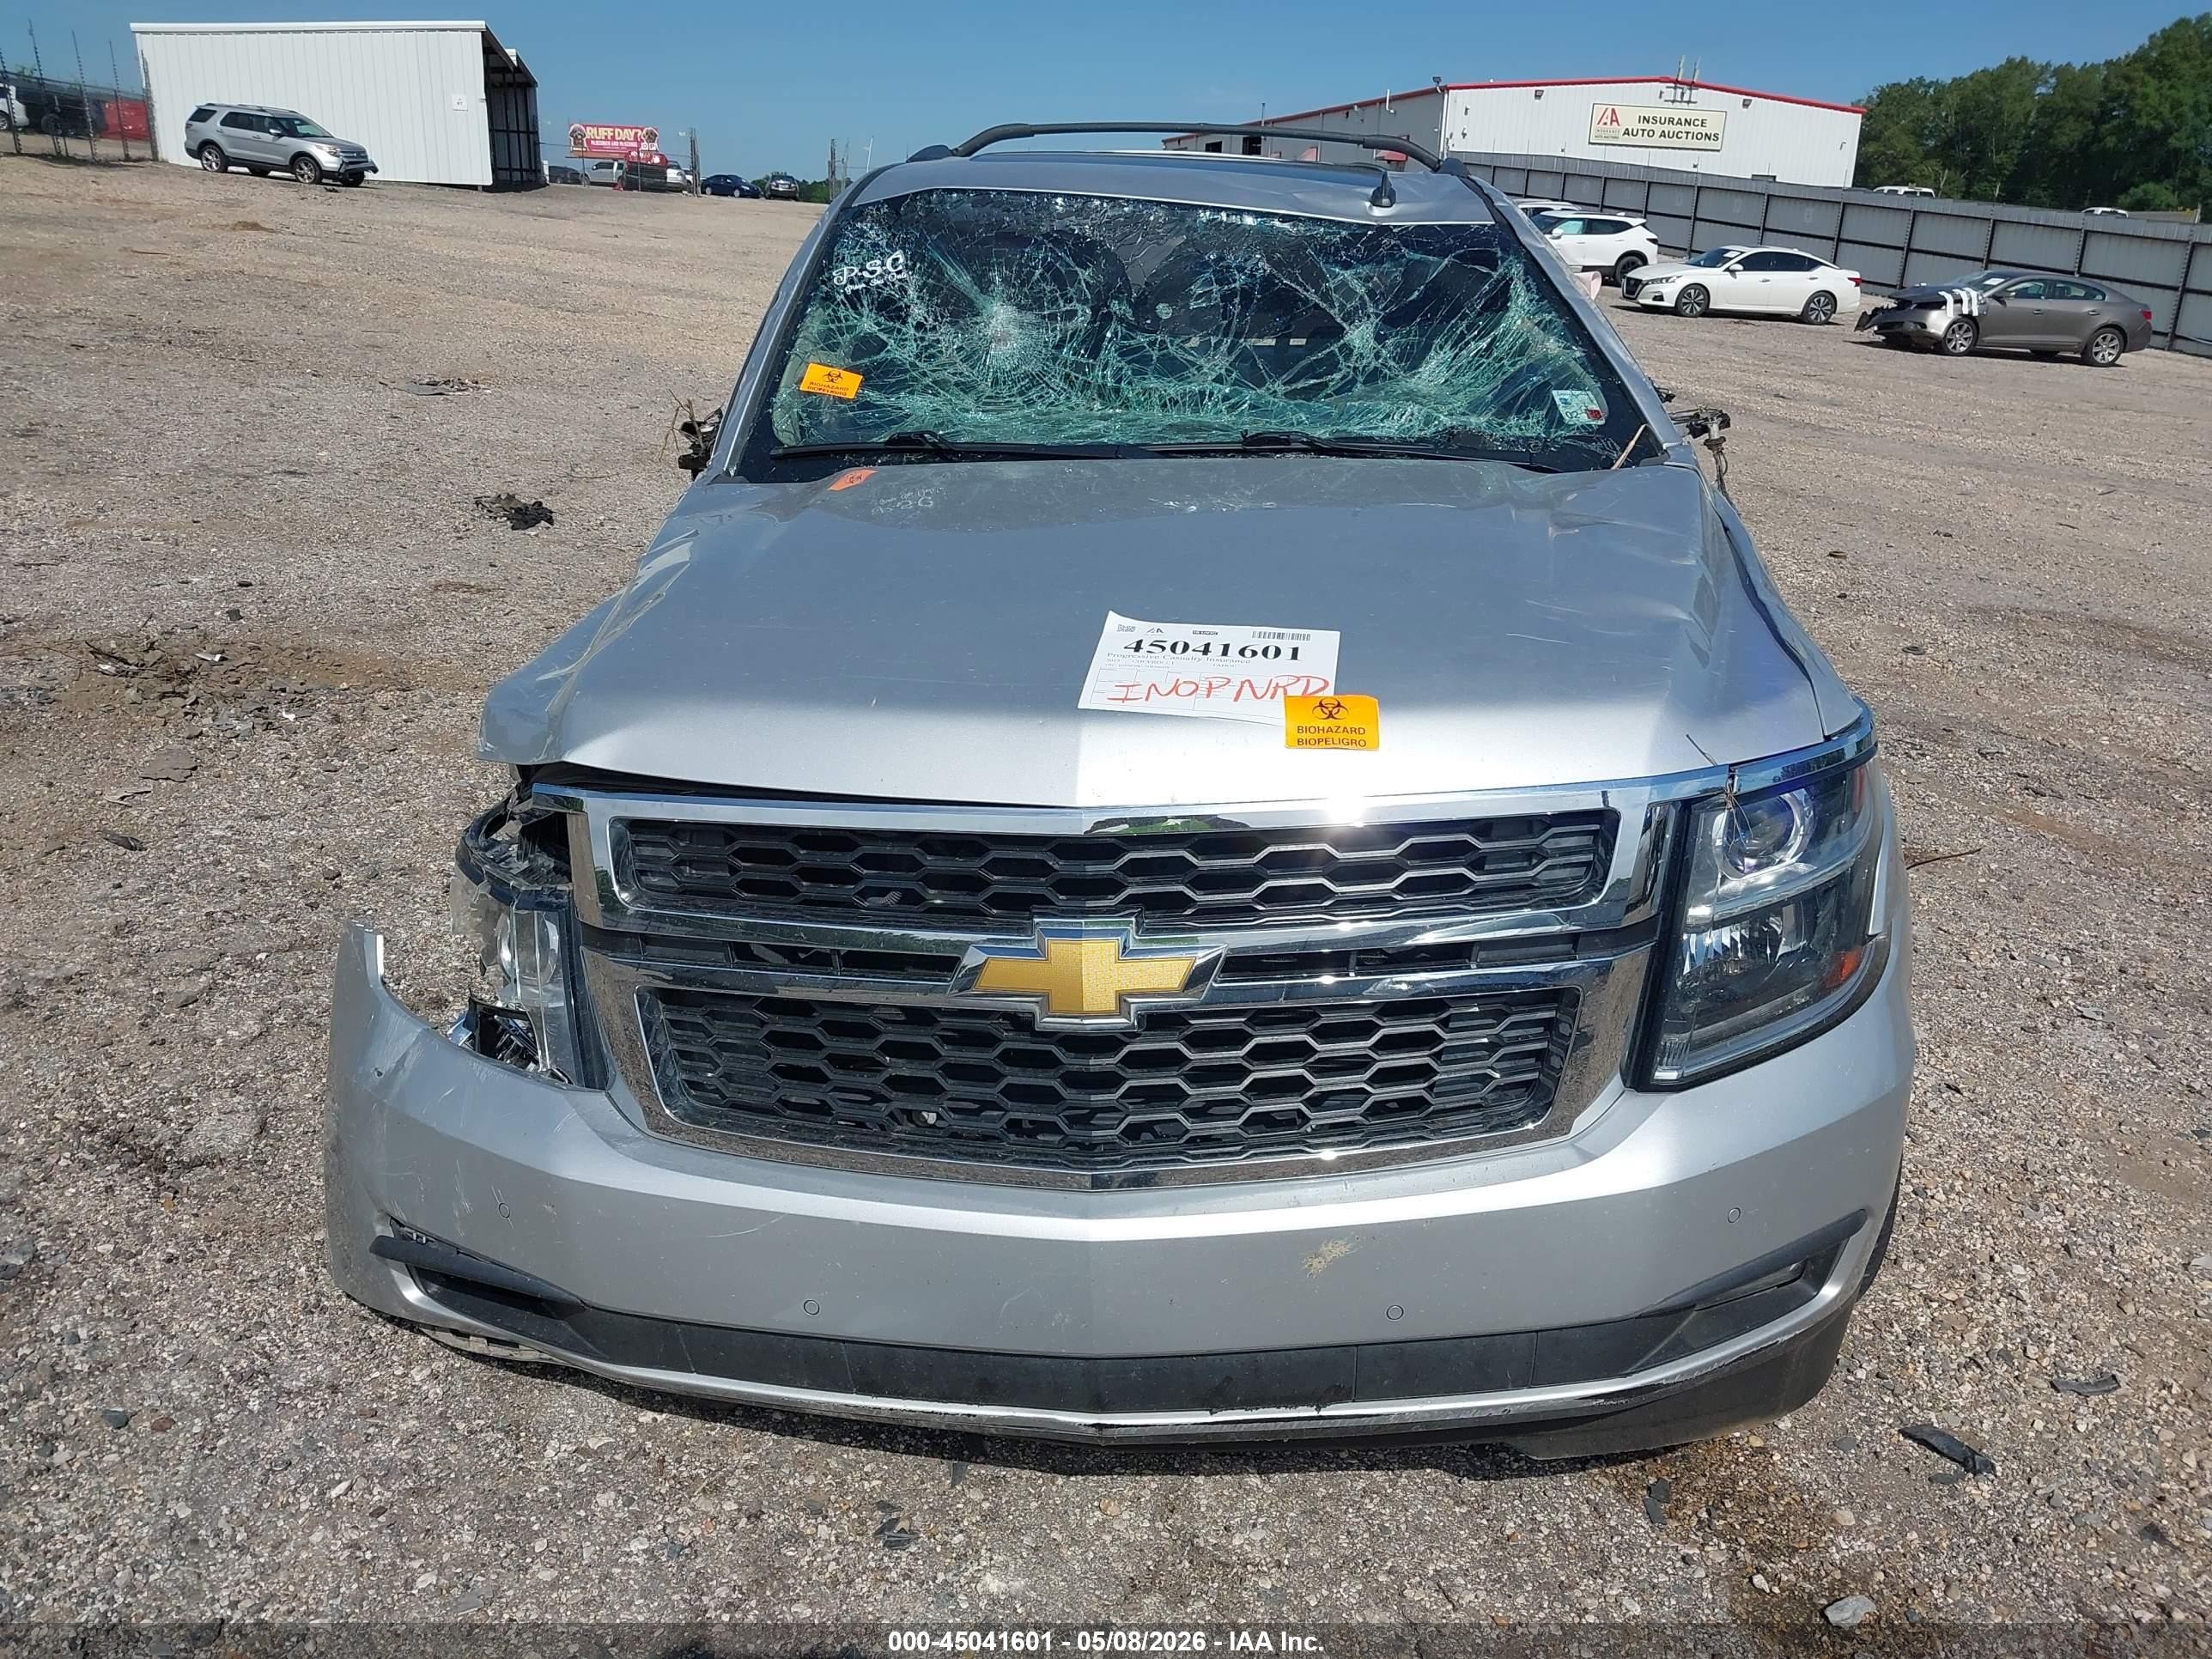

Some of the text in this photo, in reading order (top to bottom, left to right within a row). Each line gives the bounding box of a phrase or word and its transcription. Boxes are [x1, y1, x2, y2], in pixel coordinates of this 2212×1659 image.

[1638, 115, 1708, 128] INSURANCE
[586, 126, 642, 142] RUFF DAY?
[1622, 128, 1720, 142] AUTO AUCTIONS
[1123, 638, 1303, 662] 45041601
[1107, 652, 1160, 661] Progressive
[1162, 654, 1203, 664] Casualty
[1297, 726, 1366, 736] BIOHAZARD
[1297, 738, 1367, 748] BIOPELIGRO
